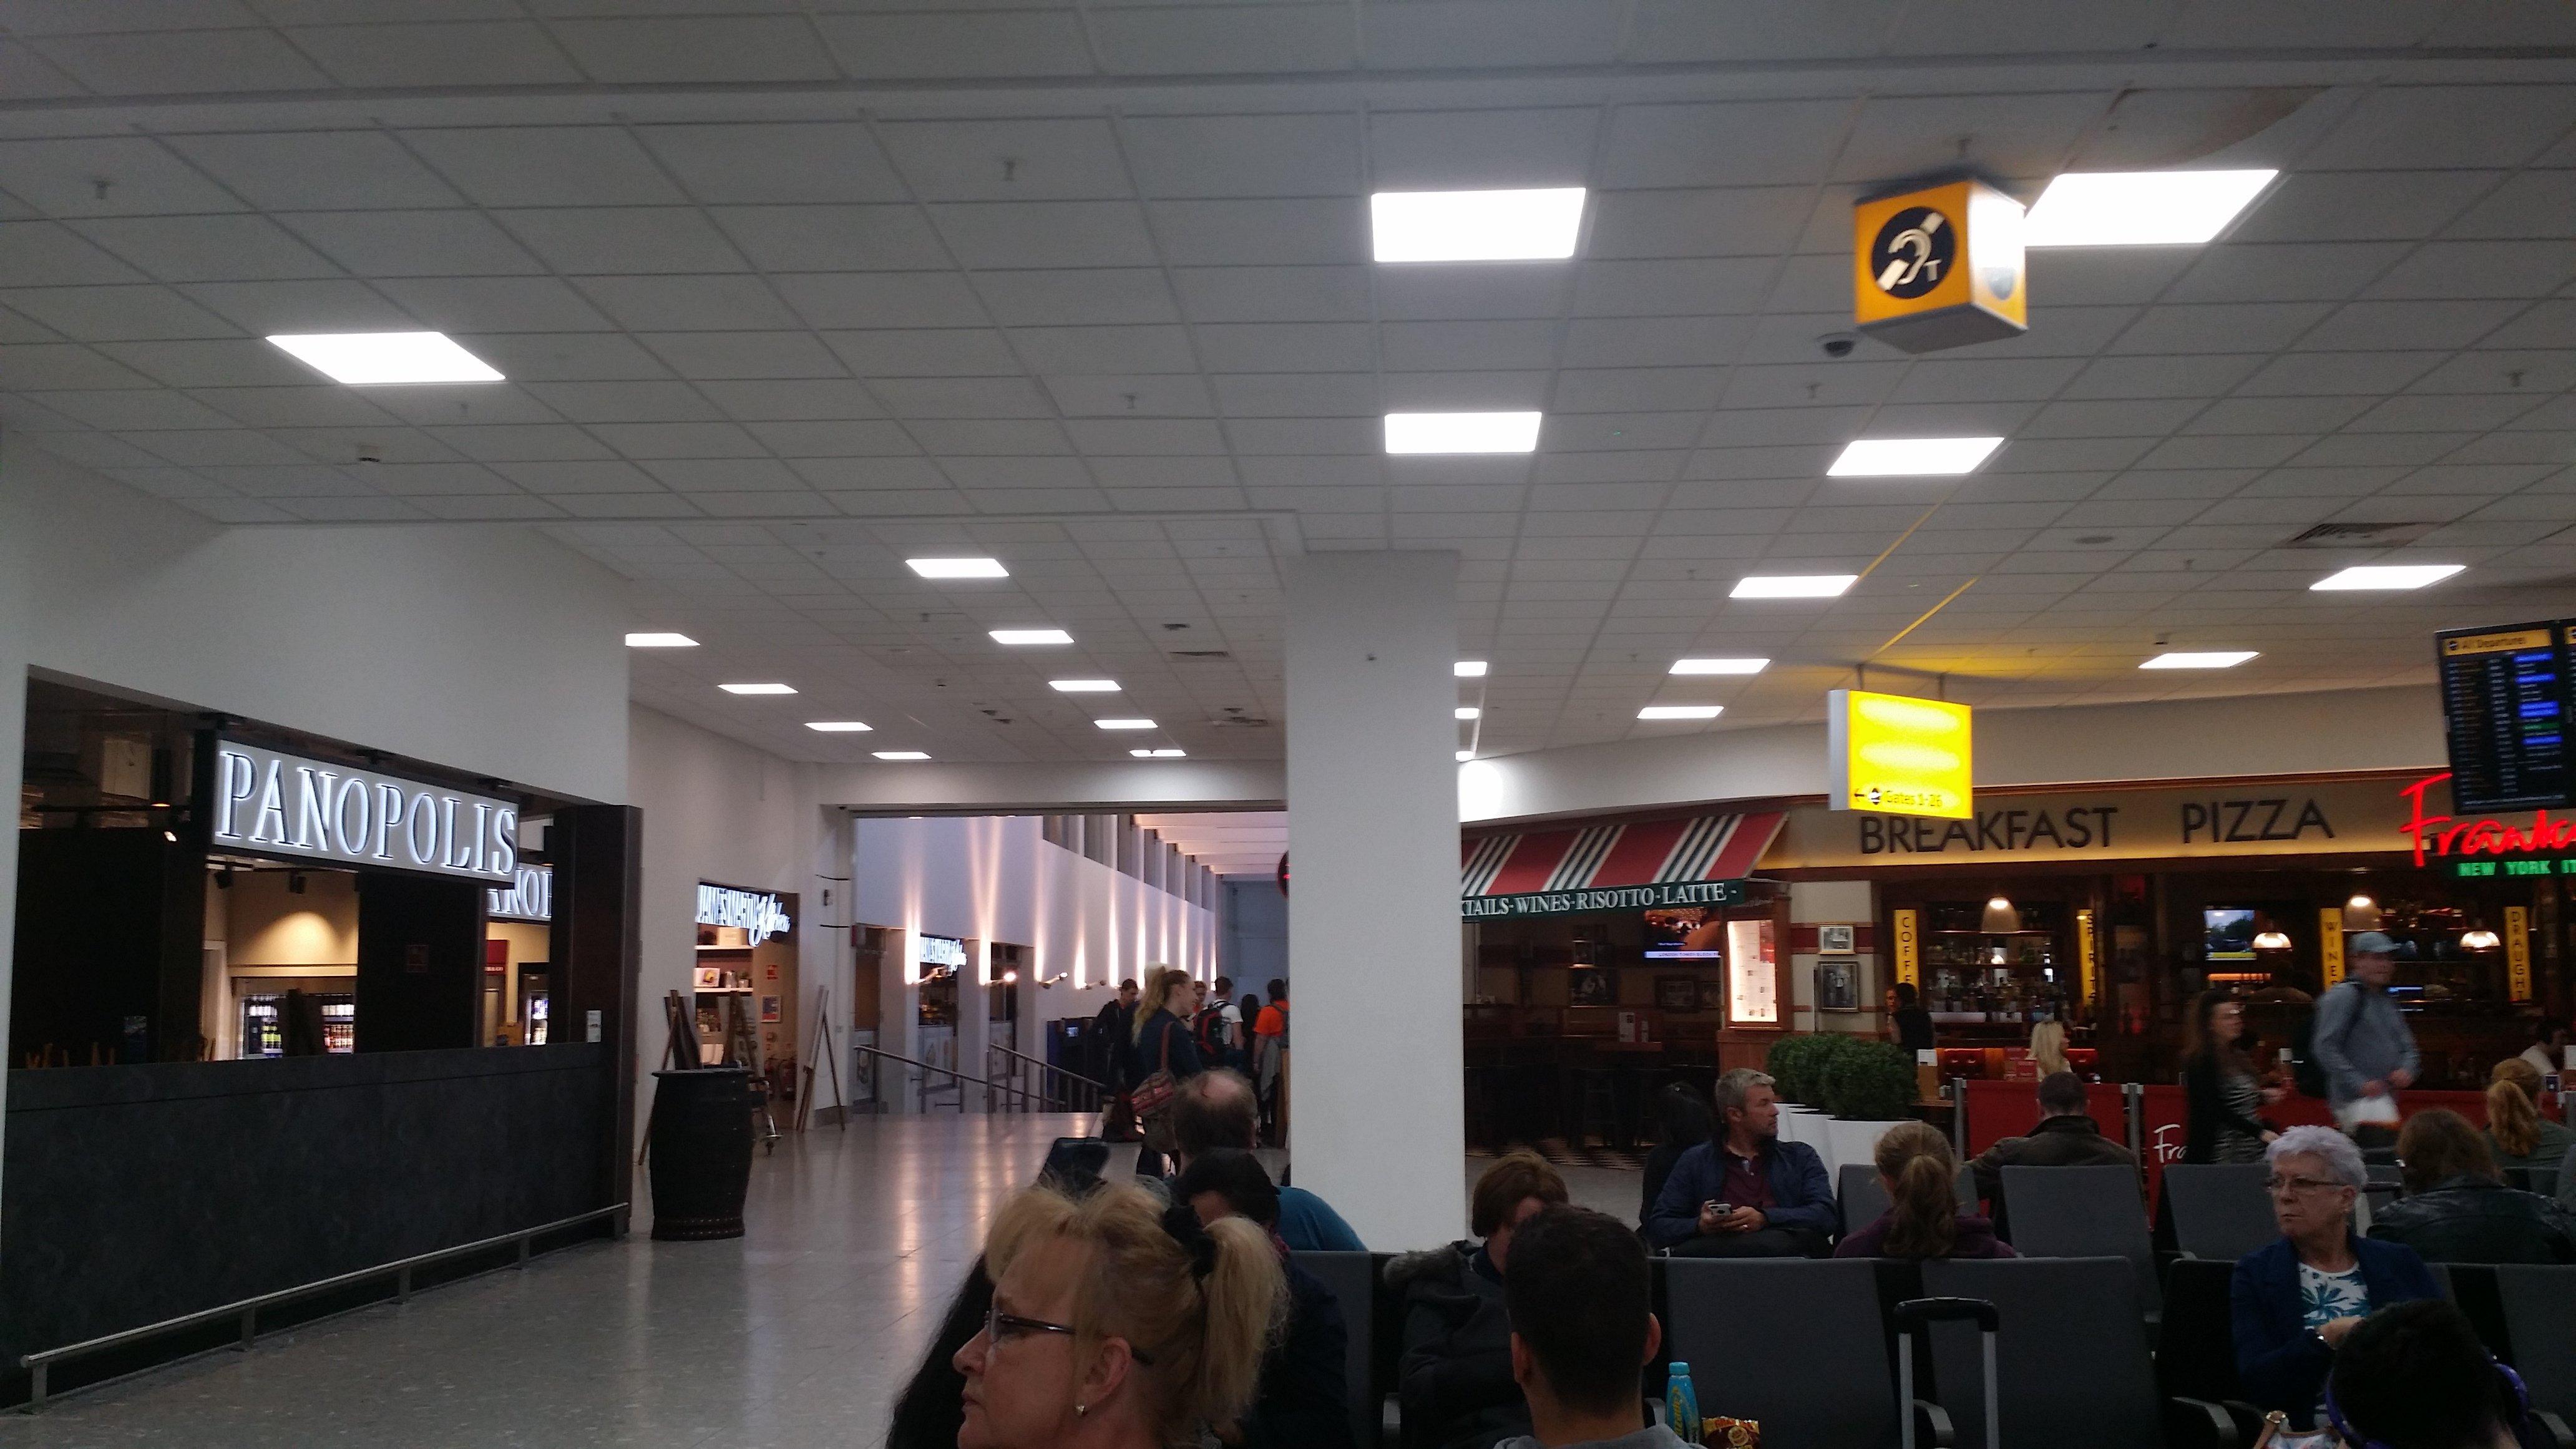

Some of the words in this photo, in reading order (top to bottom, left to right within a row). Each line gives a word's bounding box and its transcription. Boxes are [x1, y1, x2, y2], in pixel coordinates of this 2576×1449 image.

[216, 751, 517, 876] PANOPOLIS
[1861, 807, 2118, 854] BREAKFAST
[2183, 799, 2335, 843] PIZZA
[2504, 860, 2551, 875] YORK
[1462, 897, 1510, 917] TAILS
[1660, 883, 1727, 904] LATTE
[1901, 917, 1912, 983] COFFE
[2510, 911, 2525, 1000] DRAUGHT
